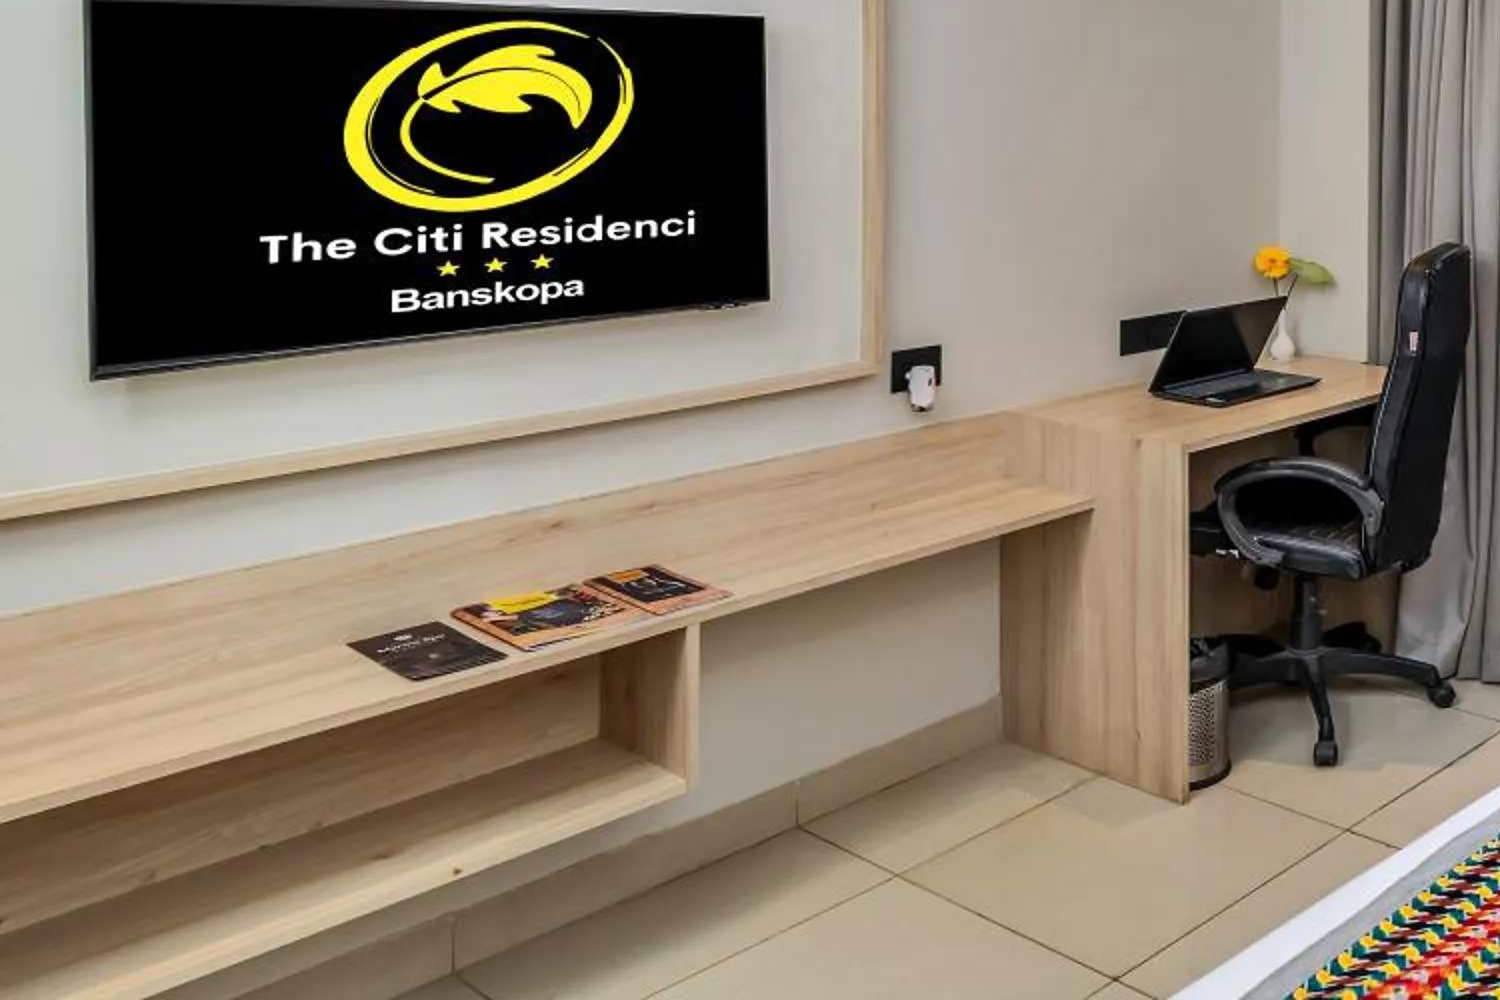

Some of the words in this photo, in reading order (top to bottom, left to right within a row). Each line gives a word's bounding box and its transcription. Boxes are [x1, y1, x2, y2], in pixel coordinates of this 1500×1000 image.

[259, 231, 357, 265] The
[373, 223, 463, 257] Citi
[481, 209, 697, 249] Residenci
[390, 278, 586, 314] Banskopa
